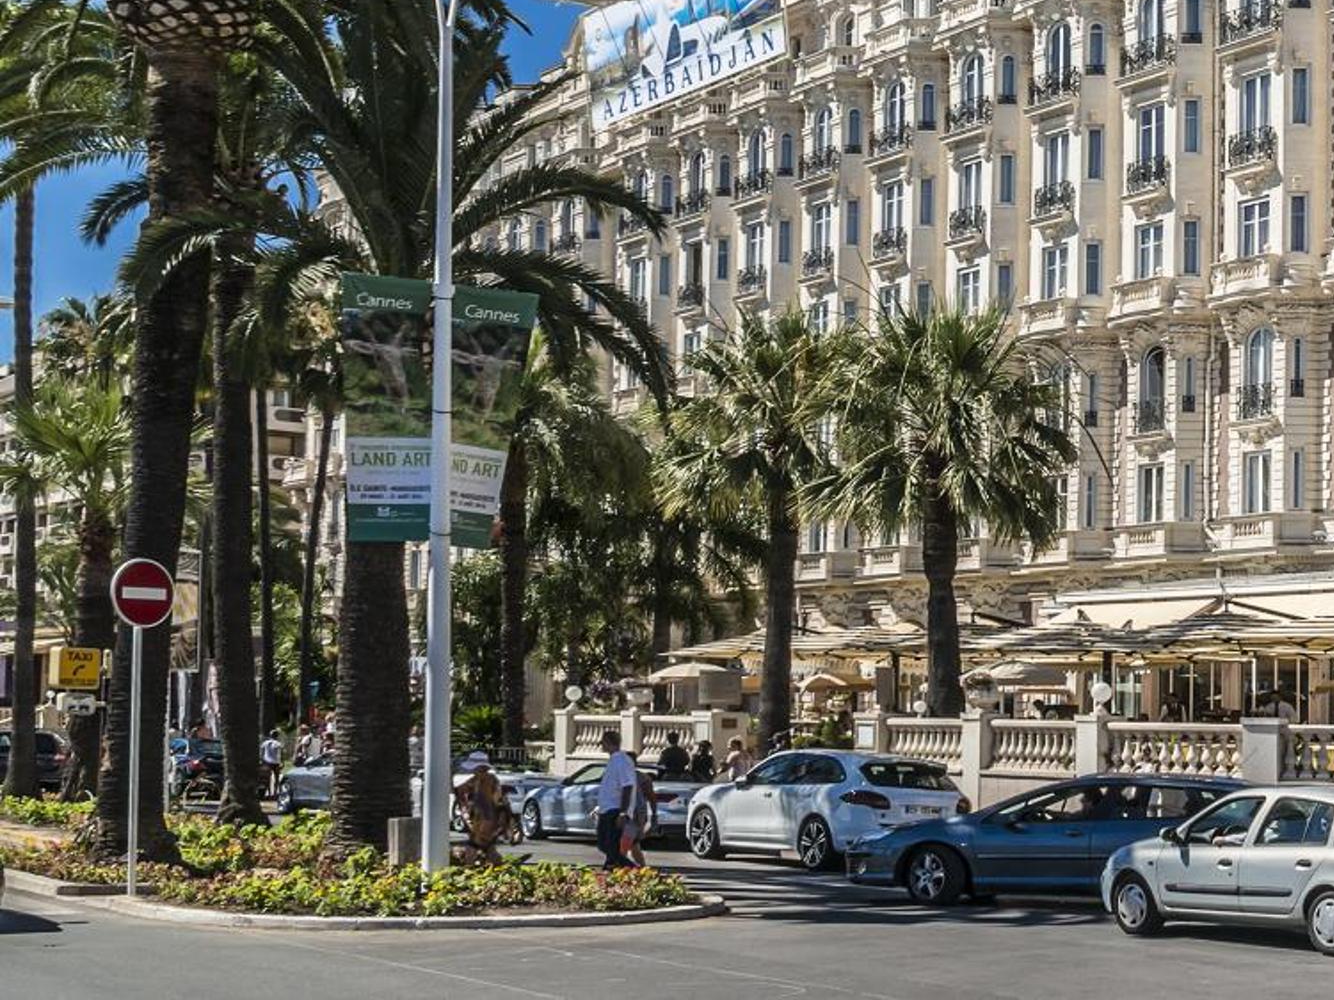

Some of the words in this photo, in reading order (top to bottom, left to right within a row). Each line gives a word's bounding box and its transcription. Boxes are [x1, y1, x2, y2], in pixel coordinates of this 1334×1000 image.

[356, 291, 413, 310] Cannes
[465, 304, 521, 324] Cannes
[351, 452, 397, 467] LAND
[402, 452, 431, 467] ART
[452, 458, 468, 475] ND
[472, 462, 502, 478] ART
[67, 651, 93, 662] TAXI
